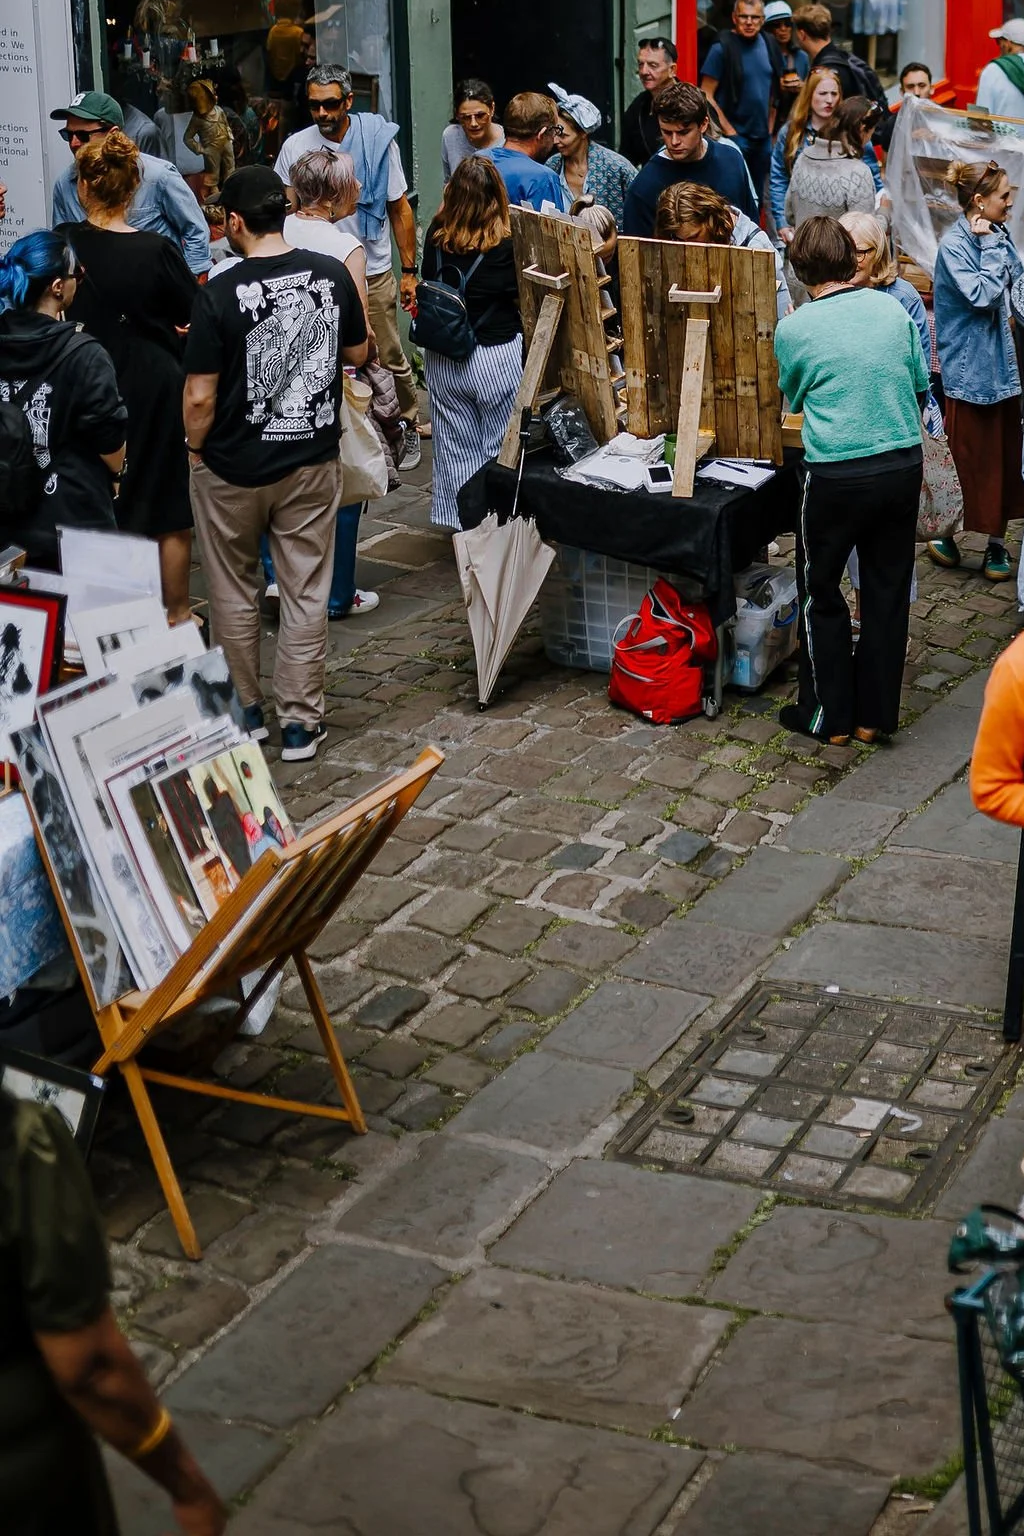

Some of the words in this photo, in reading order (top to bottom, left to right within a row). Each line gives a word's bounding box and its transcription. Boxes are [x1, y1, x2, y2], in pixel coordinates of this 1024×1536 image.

[10, 28, 18, 36] in
[11, 41, 25, 50] We
[13, 65, 33, 74] with
[13, 137, 25, 145] on
[15, 218, 25, 226] of
[284, 432, 315, 441] MAGGOT
